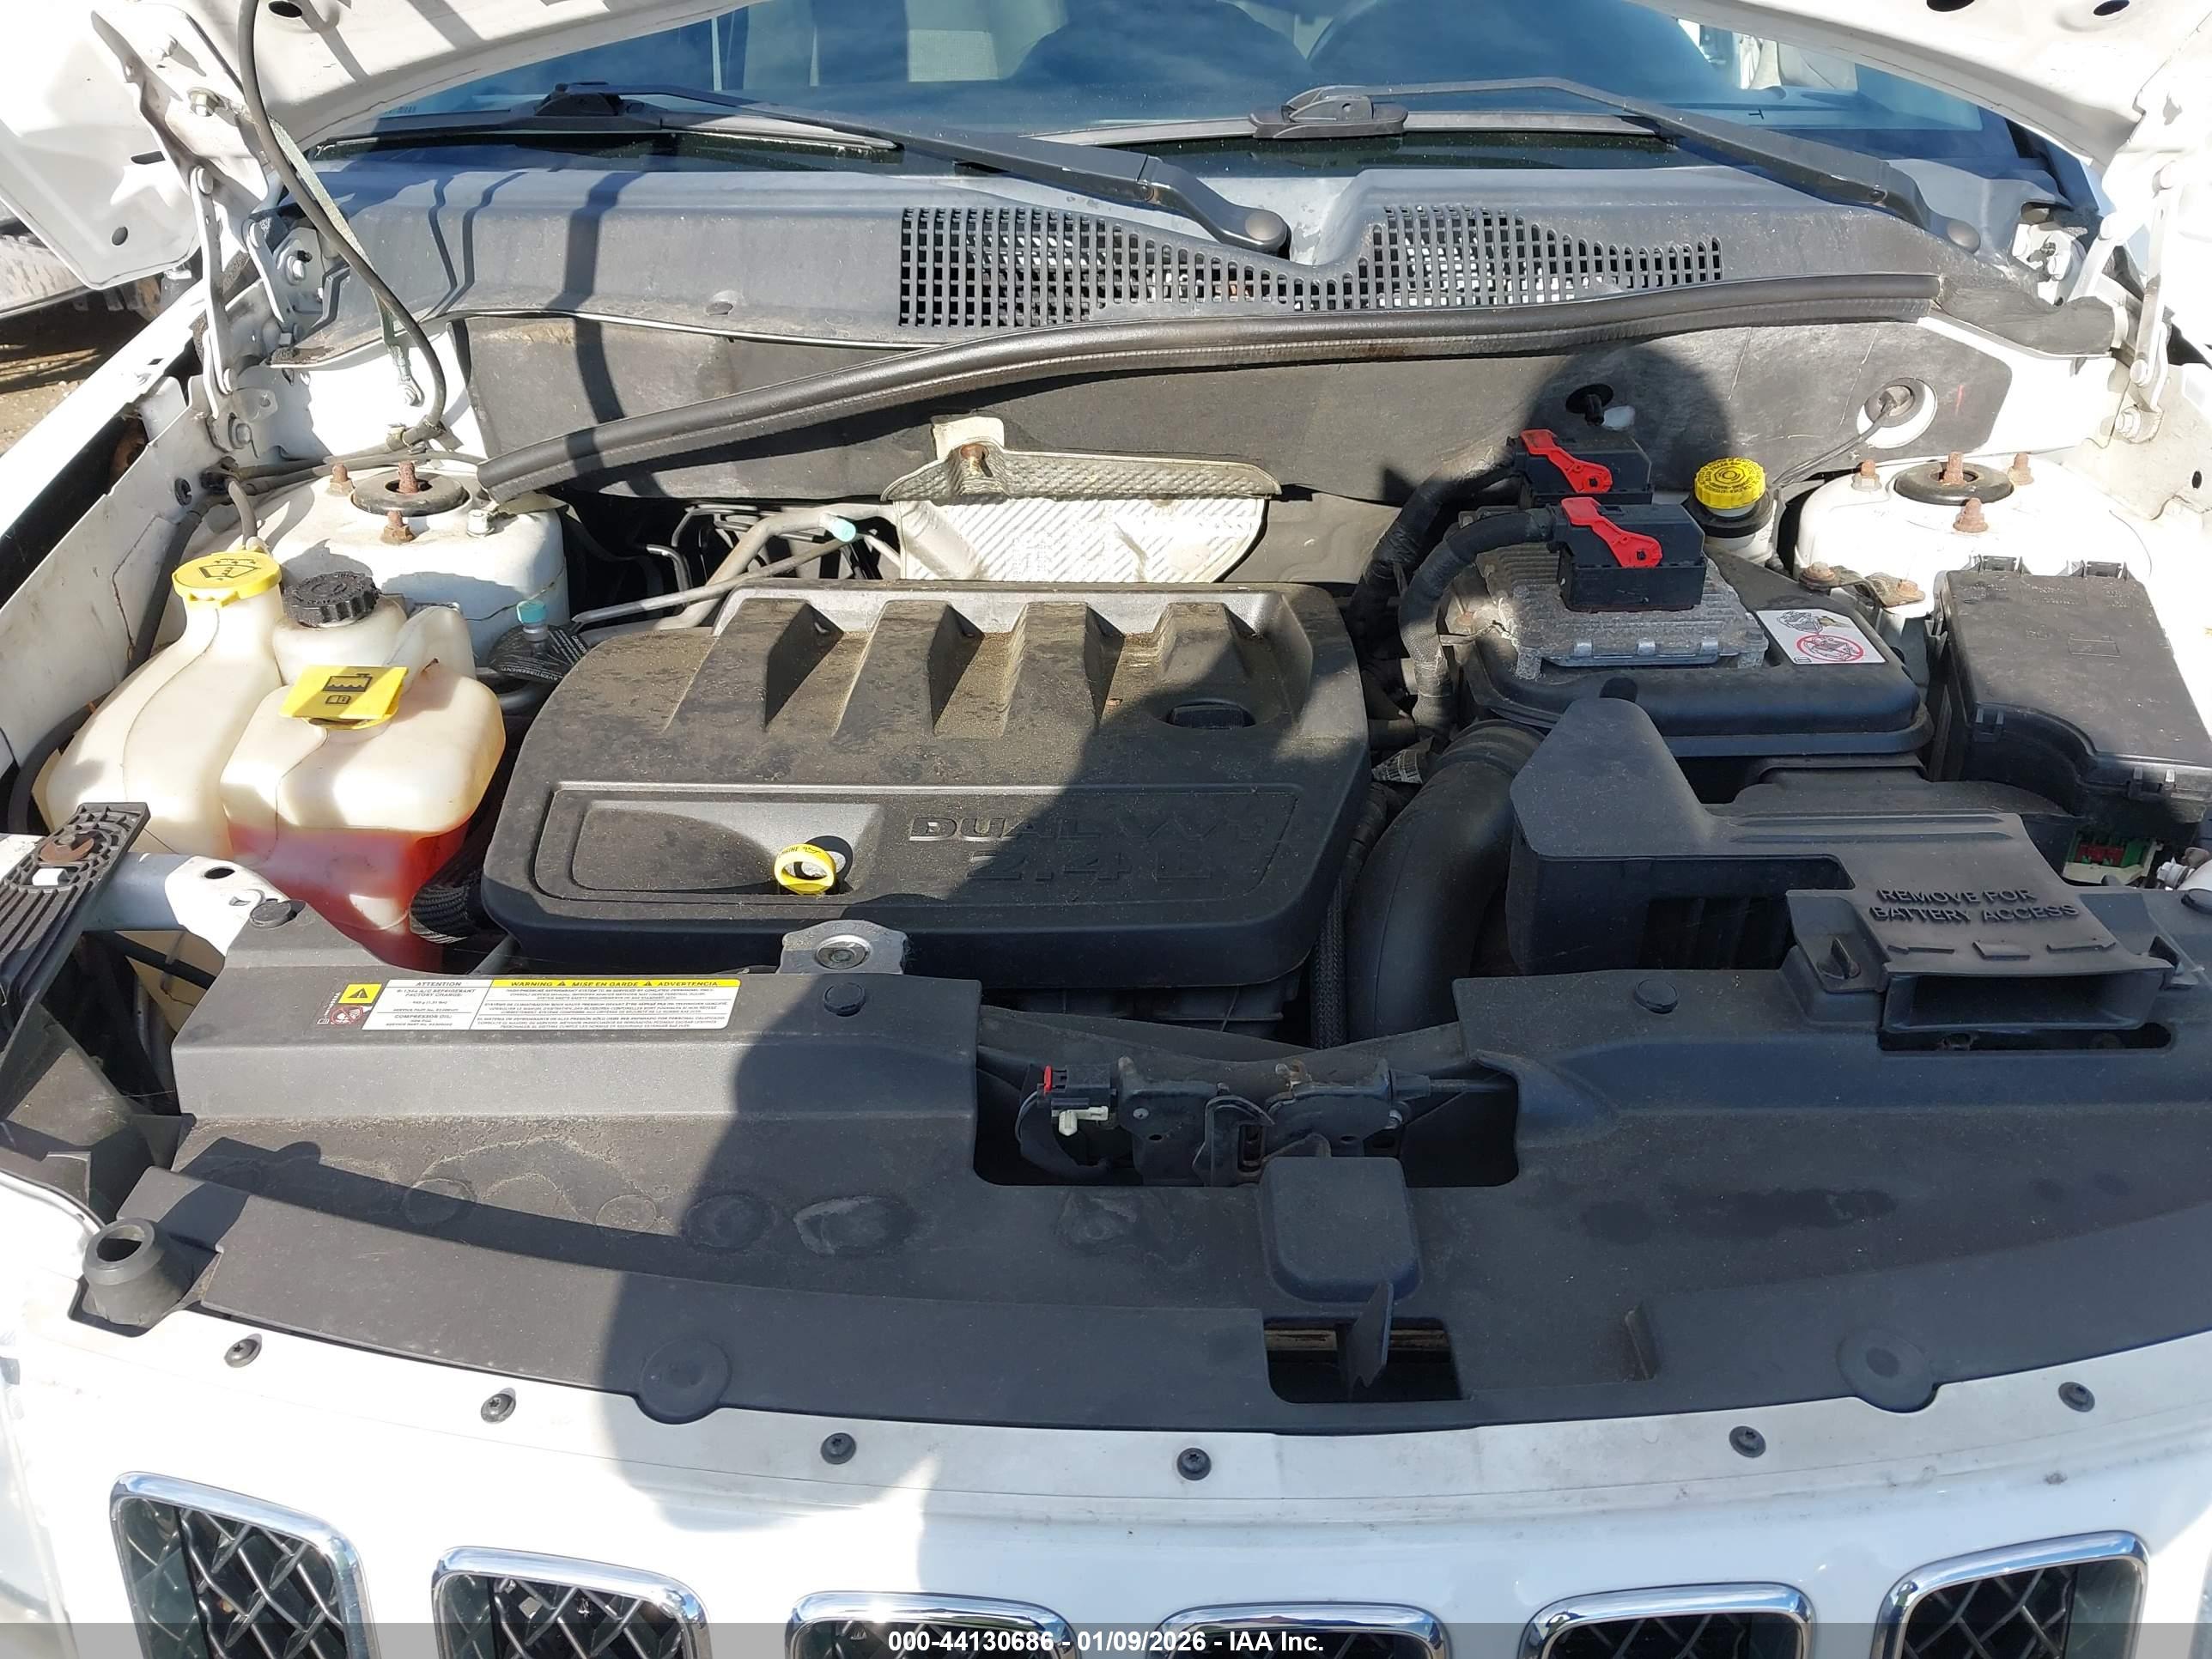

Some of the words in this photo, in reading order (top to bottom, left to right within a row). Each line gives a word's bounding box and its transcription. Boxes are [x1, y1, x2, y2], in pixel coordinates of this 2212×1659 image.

[908, 817, 1101, 842] DUAL
[1876, 888, 1980, 904] REMOVE
[1982, 888, 2038, 903] FOR
[1869, 905, 1972, 922] BATTERY
[1982, 903, 2080, 921] ACCESS
